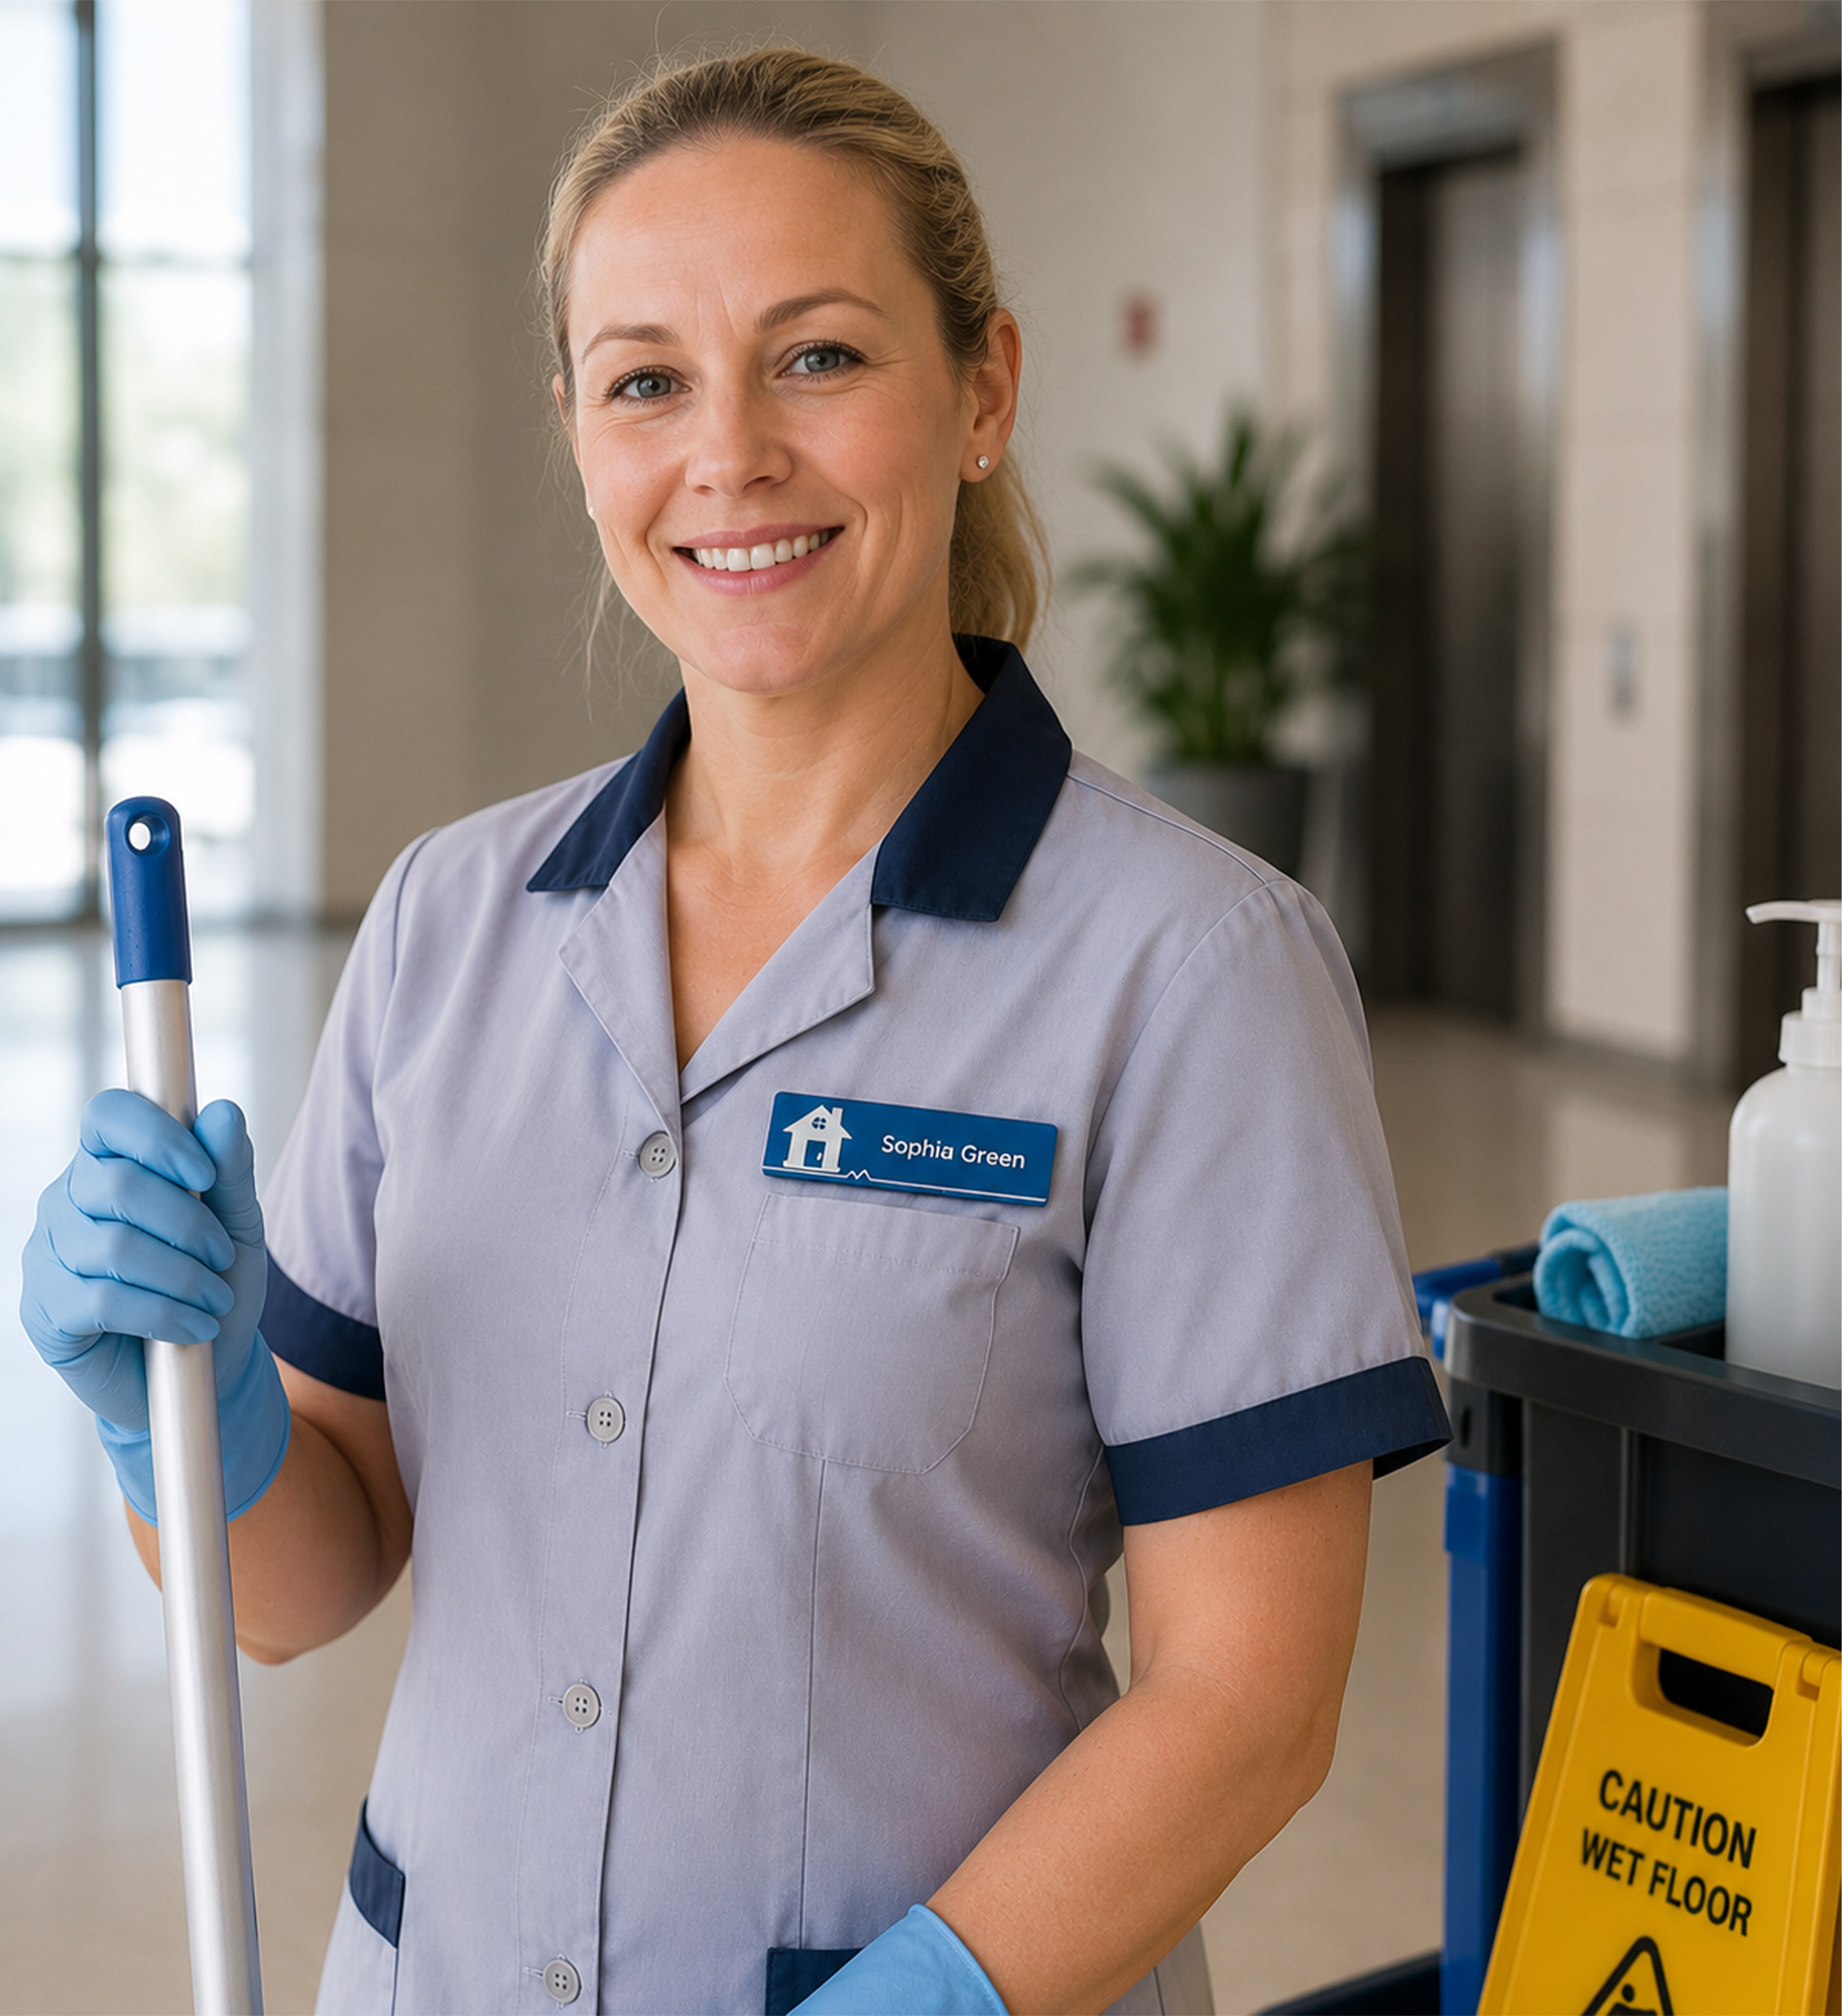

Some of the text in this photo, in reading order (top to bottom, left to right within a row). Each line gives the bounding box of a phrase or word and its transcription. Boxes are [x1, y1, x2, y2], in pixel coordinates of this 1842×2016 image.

[881, 1135, 1026, 1169] Sophia Green
[1598, 1768, 1757, 1870] CAUTION
[1581, 1827, 1753, 1937] WET FLOOR
